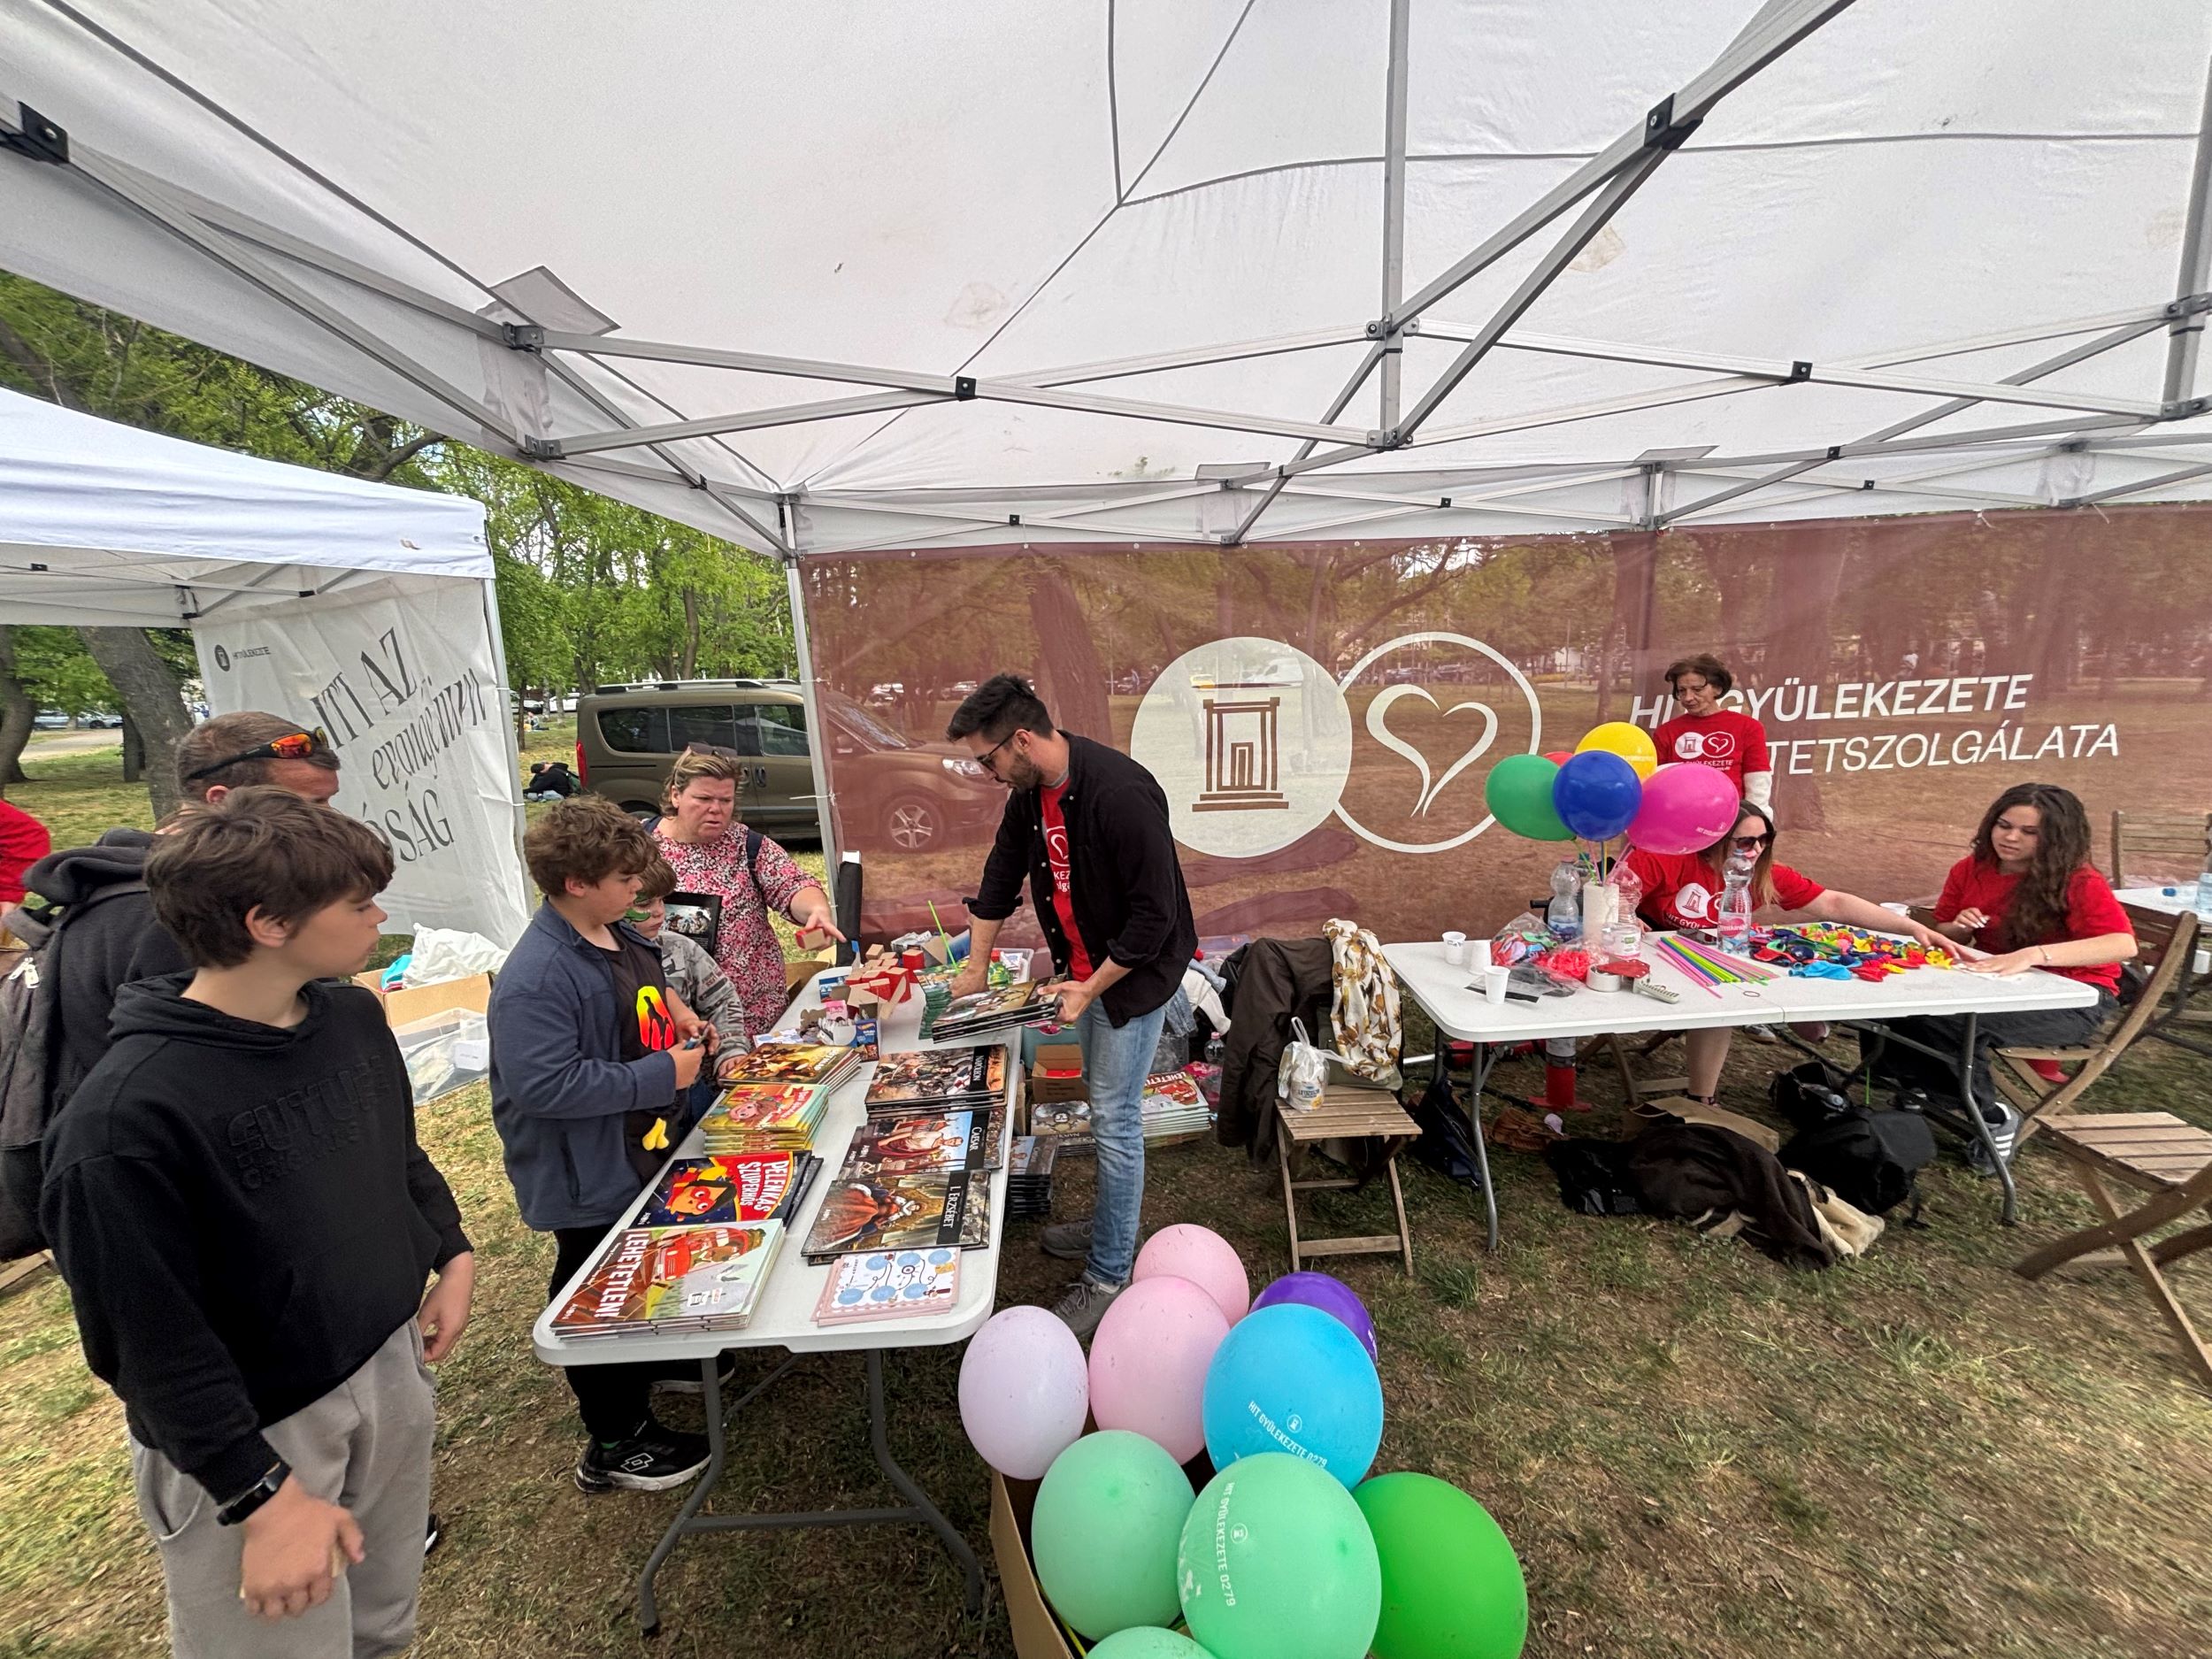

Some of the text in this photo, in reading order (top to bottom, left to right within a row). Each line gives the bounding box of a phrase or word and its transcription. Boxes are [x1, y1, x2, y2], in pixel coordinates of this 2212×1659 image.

[310, 626, 418, 749] ITT AZ
[1629, 673, 2033, 729] HI GYÜLEKEZETE
[1765, 719, 2119, 776] TETSZOLGÁLATA
[943, 1192, 961, 1228] ERZSÉBET
[595, 1233, 649, 1318] LEHETETLEN!
[1248, 1401, 1262, 1417] HIT
[1258, 1413, 1308, 1459] GYÜLEKEZETE
[1224, 1482, 1235, 1495] HIT
[1220, 1574, 1236, 1607] 0279
